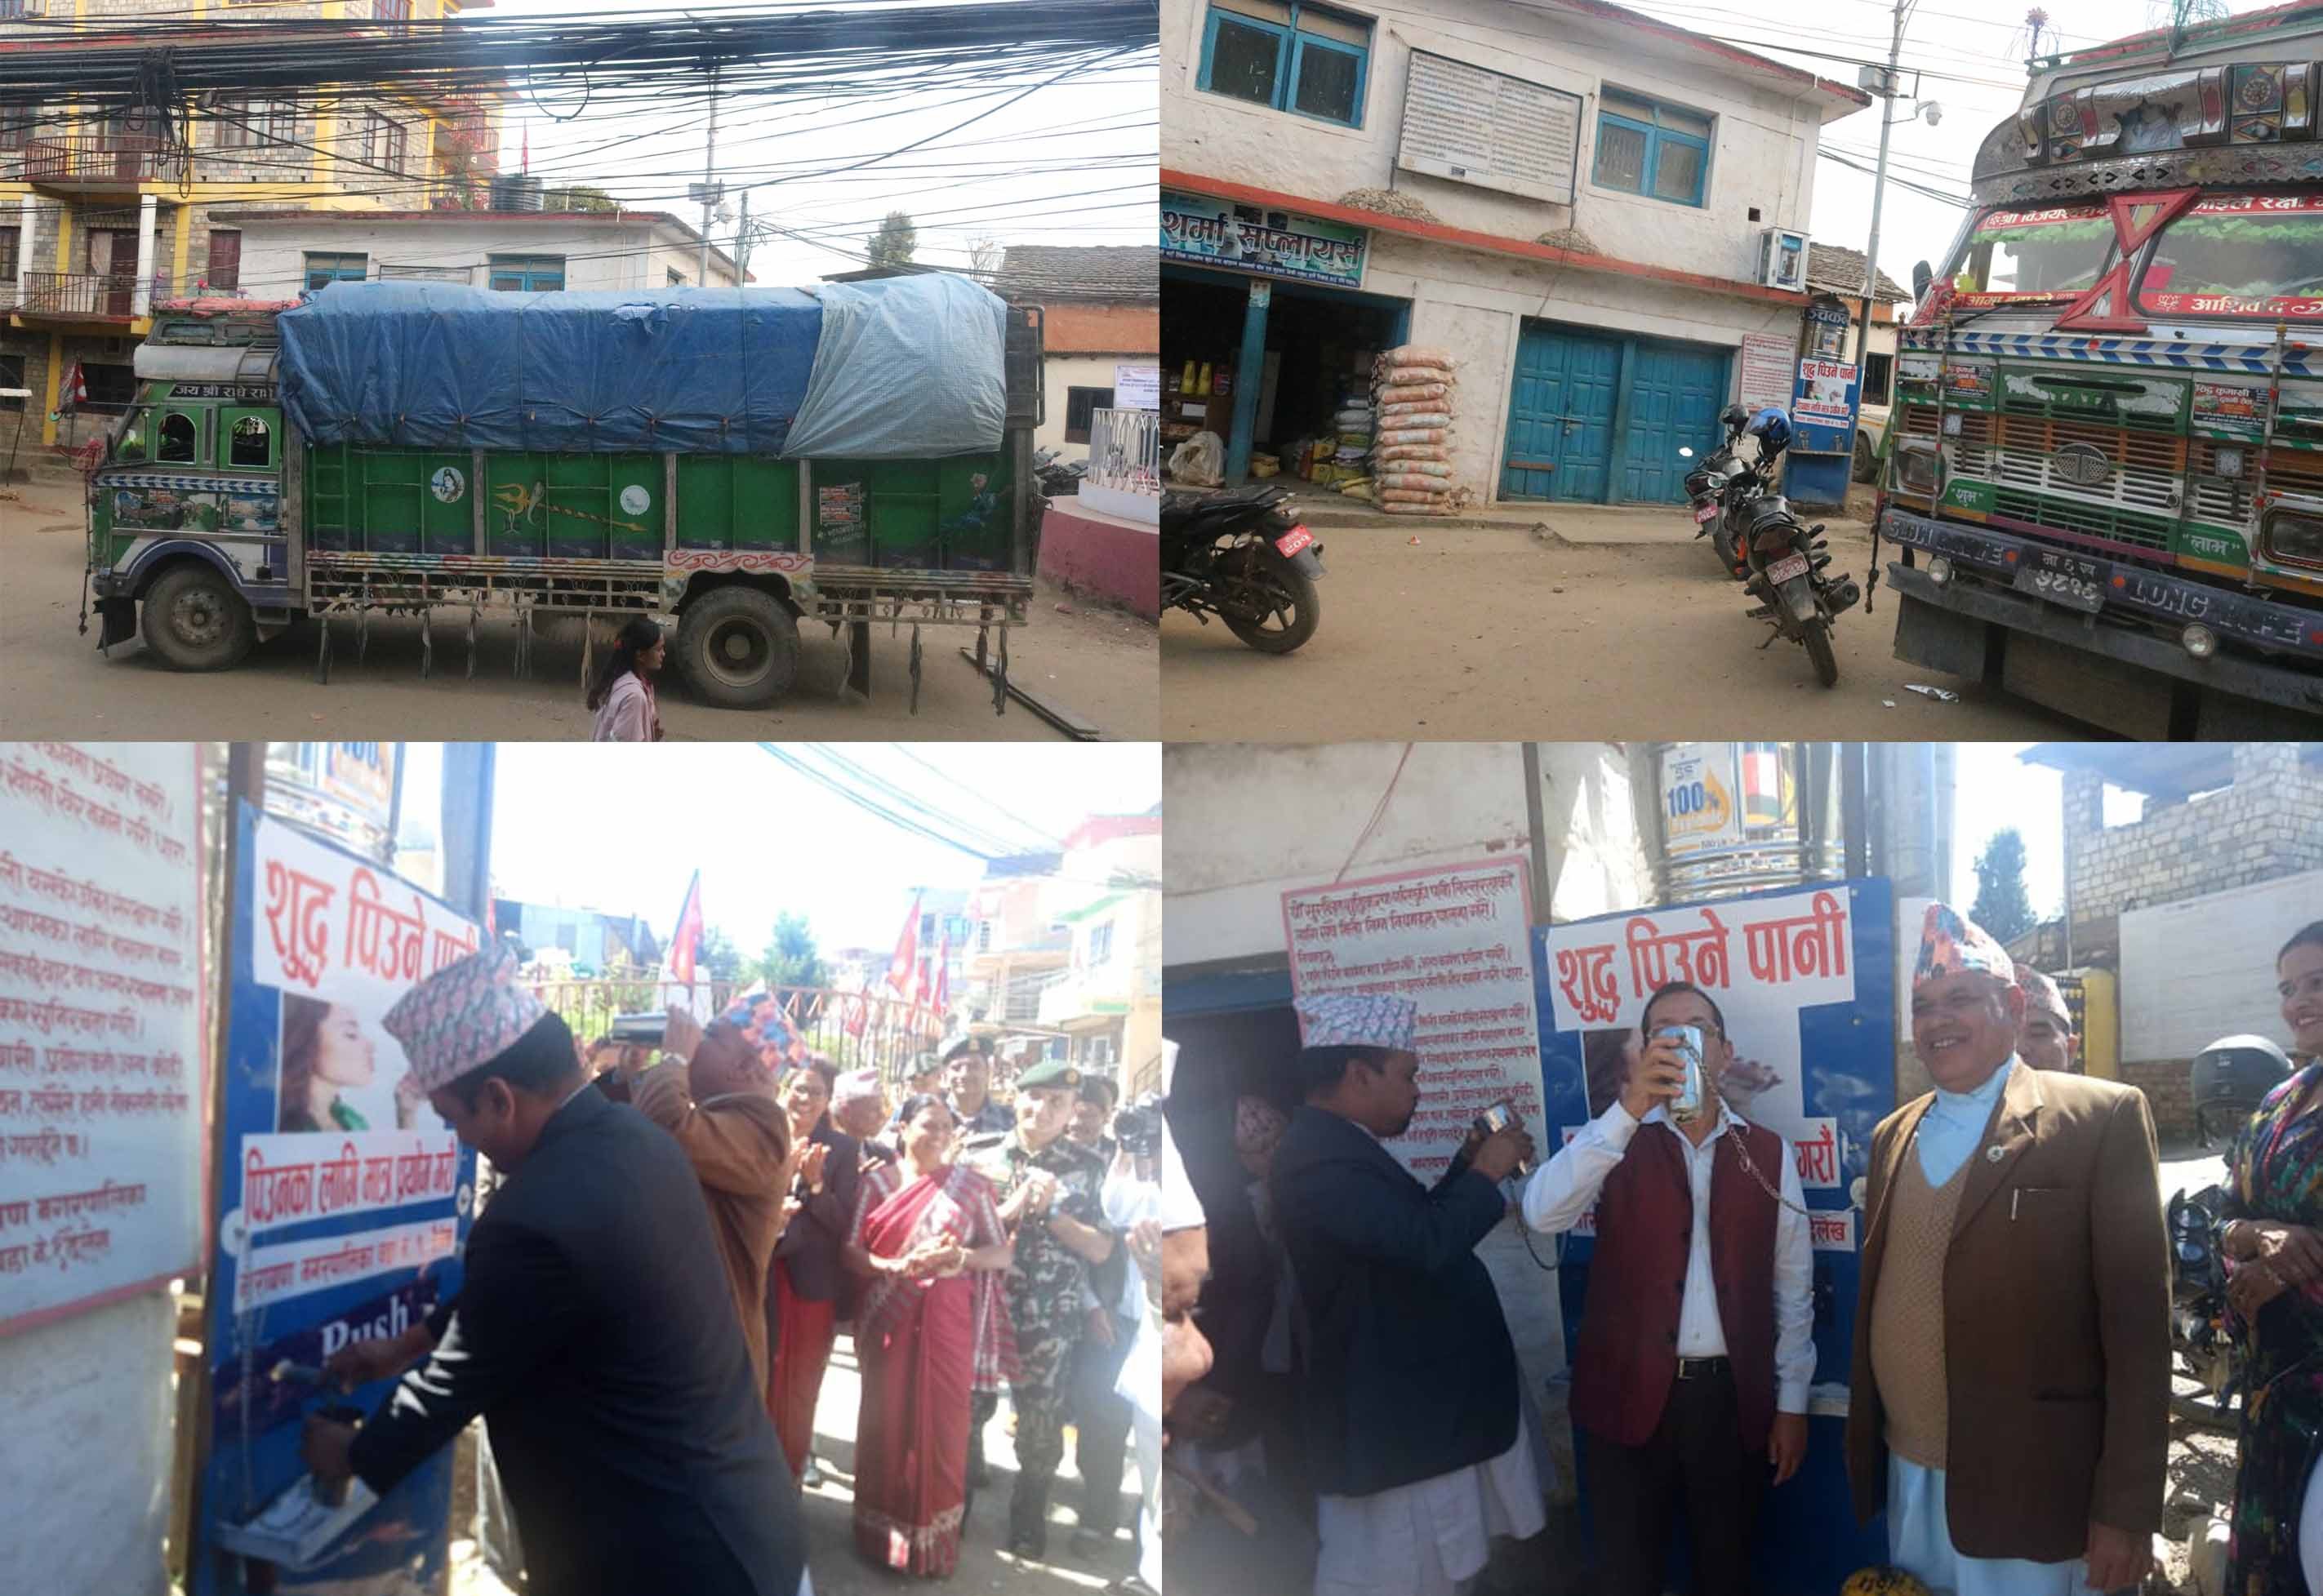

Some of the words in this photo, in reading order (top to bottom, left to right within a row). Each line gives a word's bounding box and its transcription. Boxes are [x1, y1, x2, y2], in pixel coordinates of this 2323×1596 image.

[1162, 209, 1228, 247] शर्मा
[176, 385, 200, 396] जय
[202, 385, 219, 397] श्री
[2129, 579, 2209, 618] LONG
[345, 868, 427, 985] पिउने
[1627, 908, 1729, 999] पिउने
[1742, 892, 1846, 983] पानी
